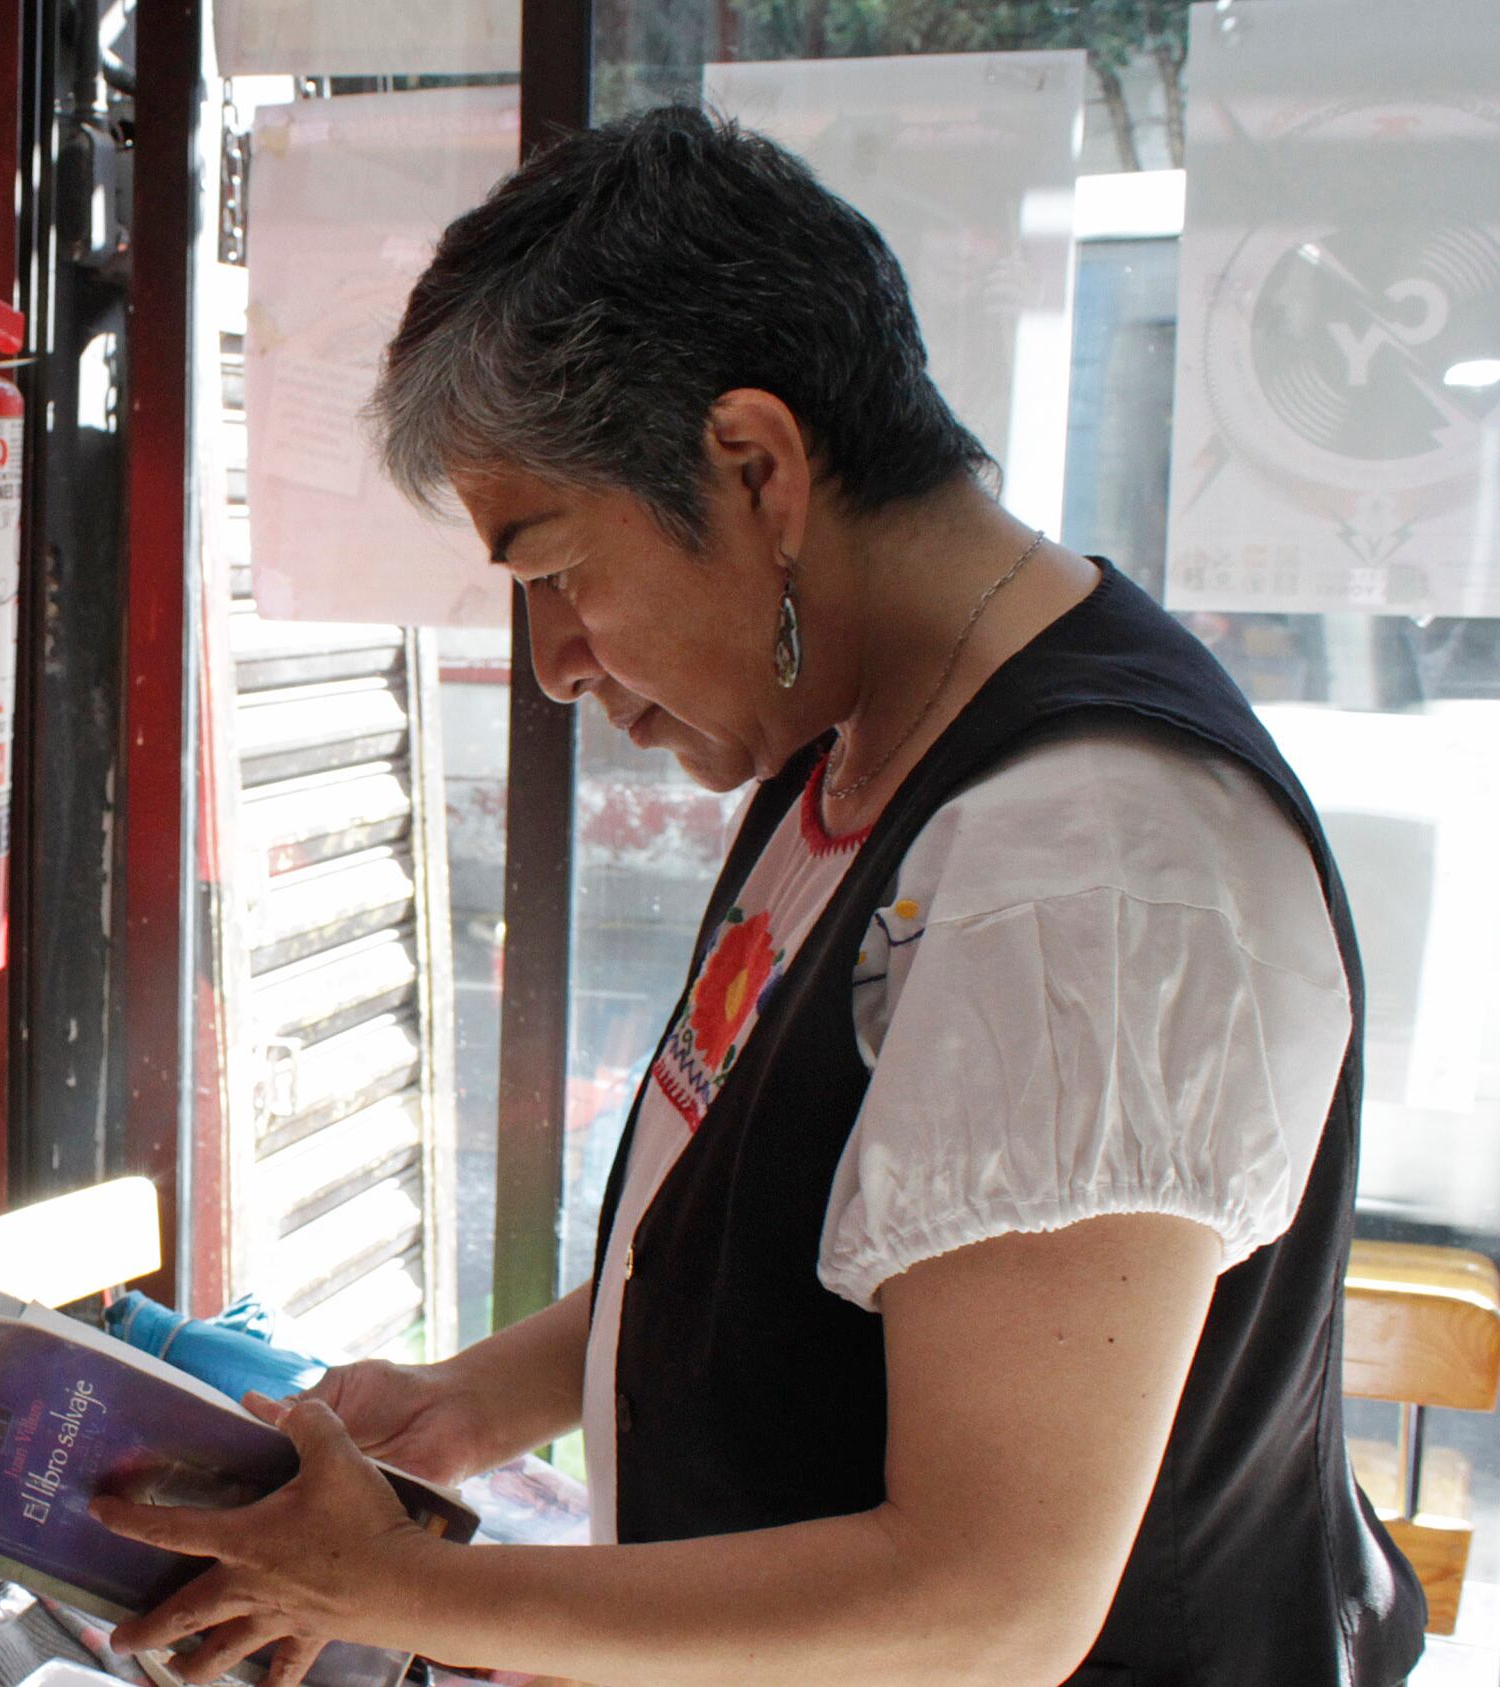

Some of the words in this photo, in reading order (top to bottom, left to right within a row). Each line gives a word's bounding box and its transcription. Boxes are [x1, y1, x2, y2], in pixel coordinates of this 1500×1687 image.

[49, 1378, 108, 1449] salvaje
[24, 1448, 70, 1498] libro
[20, 1491, 53, 1526] El
